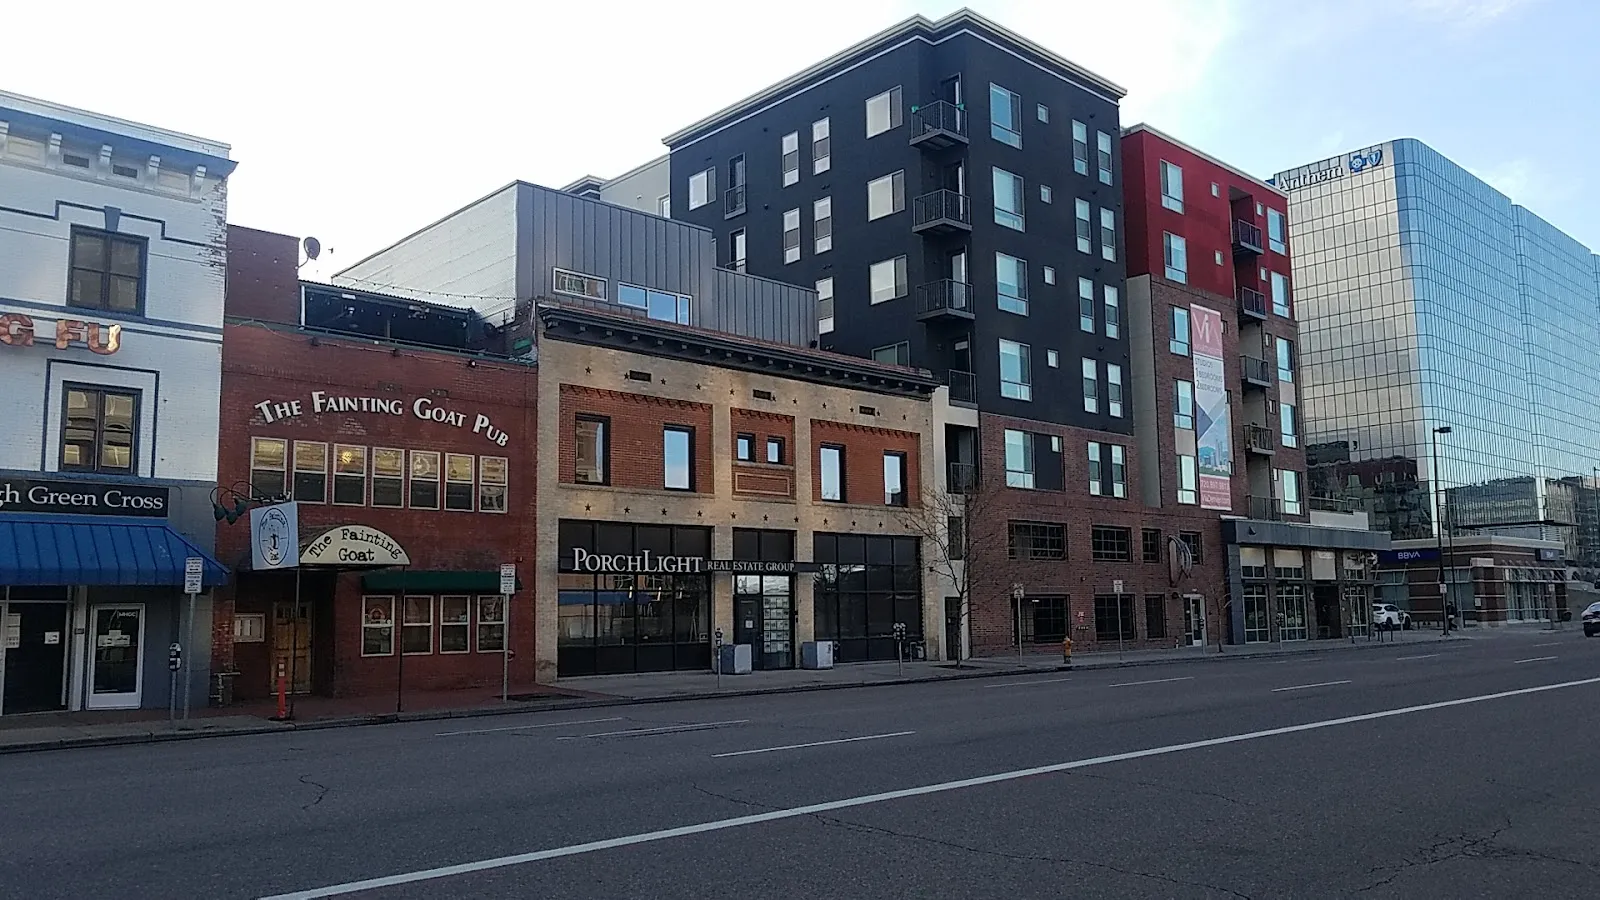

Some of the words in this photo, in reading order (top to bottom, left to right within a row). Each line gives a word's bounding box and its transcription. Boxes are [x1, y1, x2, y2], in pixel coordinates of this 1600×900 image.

[1278, 167, 1345, 191] Anthem
[56, 319, 122, 355] FU
[312, 391, 403, 415] FAINTING
[413, 398, 467, 427] GOAT
[472, 413, 509, 447] PUB
[28, 486, 97, 507] Green
[103, 490, 164, 509] Cross
[308, 535, 333, 558] The
[341, 528, 402, 560] Fainting
[338, 547, 375, 562] Goat
[1397, 551, 1421, 560] BBVA
[707, 561, 731, 571] REAL
[733, 561, 764, 571] ESTATE
[766, 562, 795, 572] GROUP
